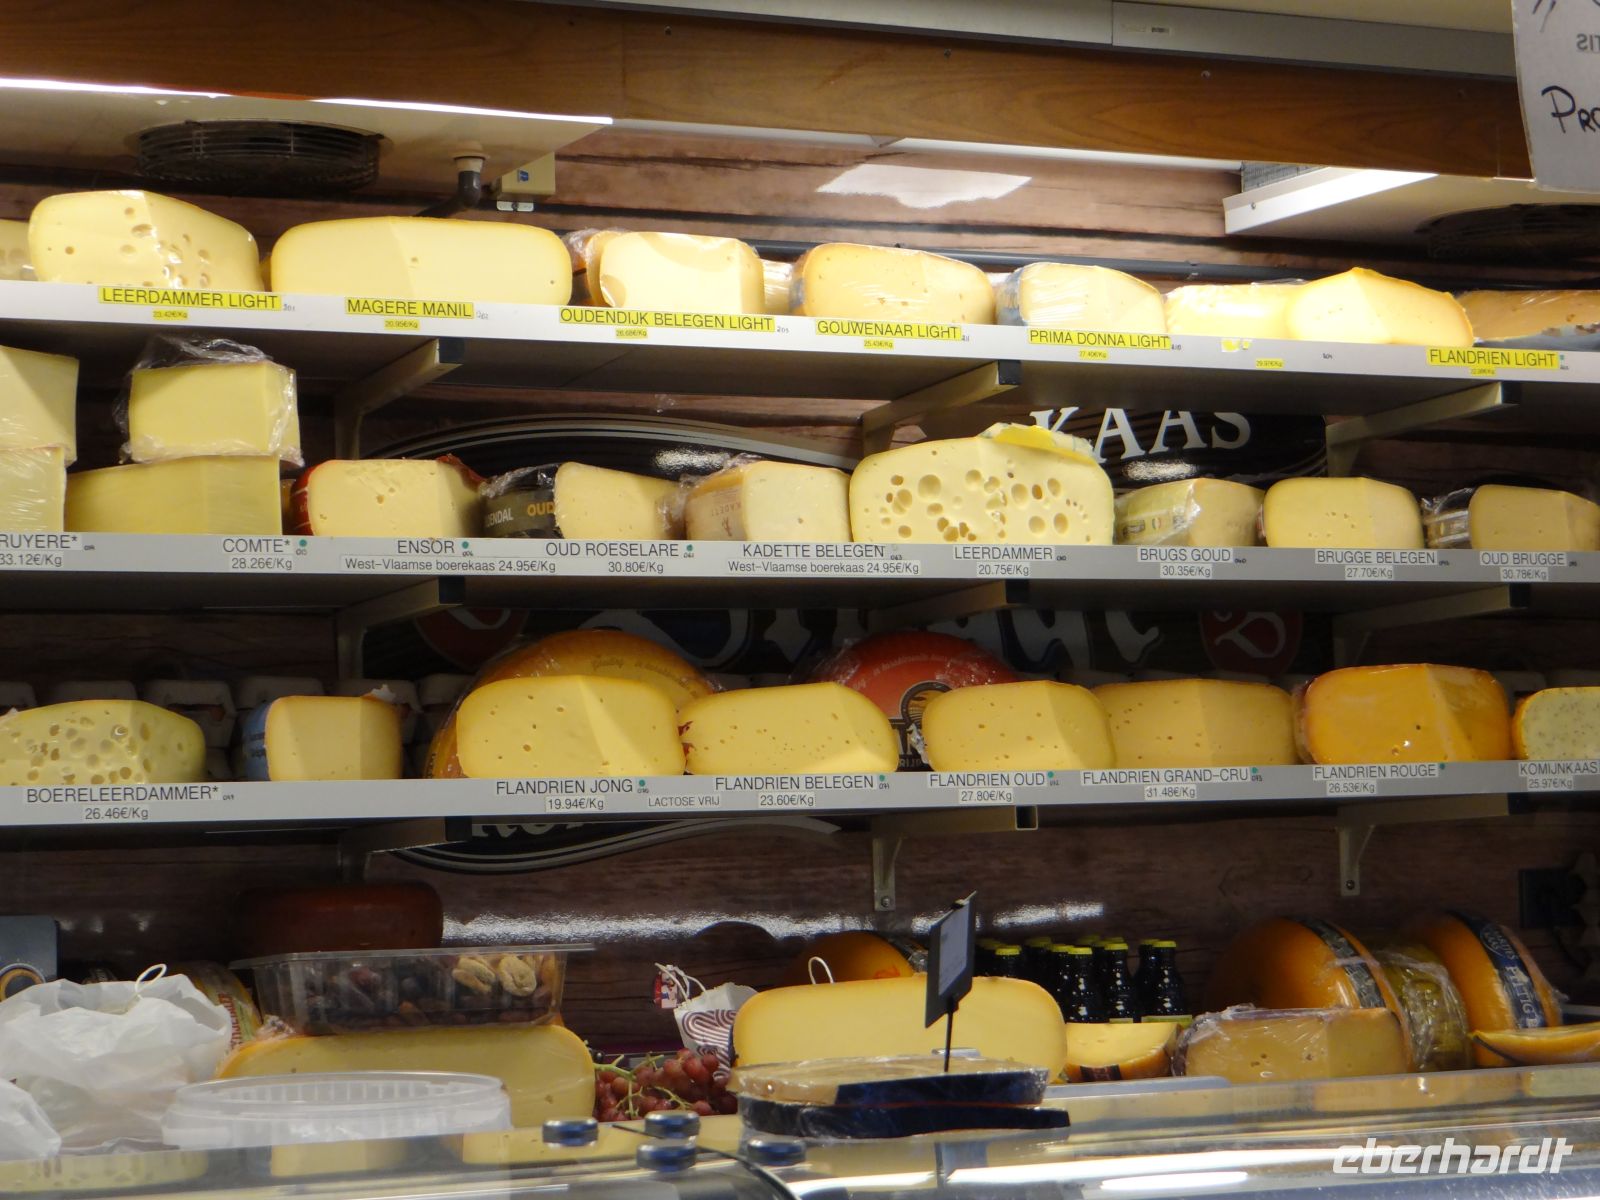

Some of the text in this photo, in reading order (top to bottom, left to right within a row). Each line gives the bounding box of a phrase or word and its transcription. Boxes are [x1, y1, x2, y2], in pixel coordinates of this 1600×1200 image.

[103, 288, 278, 309] LEERDAMMER LIGHT
[347, 299, 472, 318] MAGERE MANIL
[560, 308, 773, 331] OUDENDIJK BELEGEN LIGHT
[817, 320, 958, 340] GOUWENAAR LIGHT
[1030, 330, 1170, 349] PRIMA DONNA LIGHT
[1430, 349, 1556, 368] FLANDRIEN LIGHT
[397, 540, 454, 554] ENSOR
[545, 542, 679, 557] OUD ROESELARE
[743, 544, 886, 559] KADETTE BELEGEN
[954, 546, 1053, 560] LEERDAMMER
[1140, 548, 1231, 562] BRUGS GOUD
[1317, 550, 1372, 564] BRUGGE
[1376, 551, 1436, 565] BELEGEN
[1481, 552, 1509, 565] OUD
[1512, 553, 1565, 566] BRUGGE
[231, 557, 292, 571] 28.26€/Kg
[345, 558, 556, 574] West-Vlaamse boerekaas 24.95€/Kg
[608, 561, 664, 575] 30.80€/Kg
[728, 561, 919, 576] West-Vlaamse boerekaas 24.95€/Kg
[978, 564, 1030, 577] 20.75€/Kg
[1162, 565, 1211, 578] 30.35€/Kg
[1346, 567, 1393, 579] 27.70€/Kg
[1502, 568, 1547, 581] 30.78€/Kg
[1083, 768, 1248, 785] FLANDRIEN GRAND-CRU
[1314, 763, 1436, 780] FLANDRIEN ROUGE
[496, 778, 634, 795] FLANDRIEN JONG
[715, 775, 874, 792] FLANDRIEN BELEGEN
[930, 772, 1045, 788] FLANDRIEN OUD
[1528, 777, 1573, 790] 25.97€/Kg
[1146, 785, 1196, 799] 31.48€/Kg
[1328, 782, 1375, 795] 26.53€/Kg
[548, 797, 605, 812] 19.94€/Kg
[648, 795, 720, 808] LACTOSE VRIJ
[760, 793, 815, 808] 23.60€/Kg
[961, 790, 1013, 804] 27.80€/Kg
[84, 806, 149, 821] 26.46€/Kg
